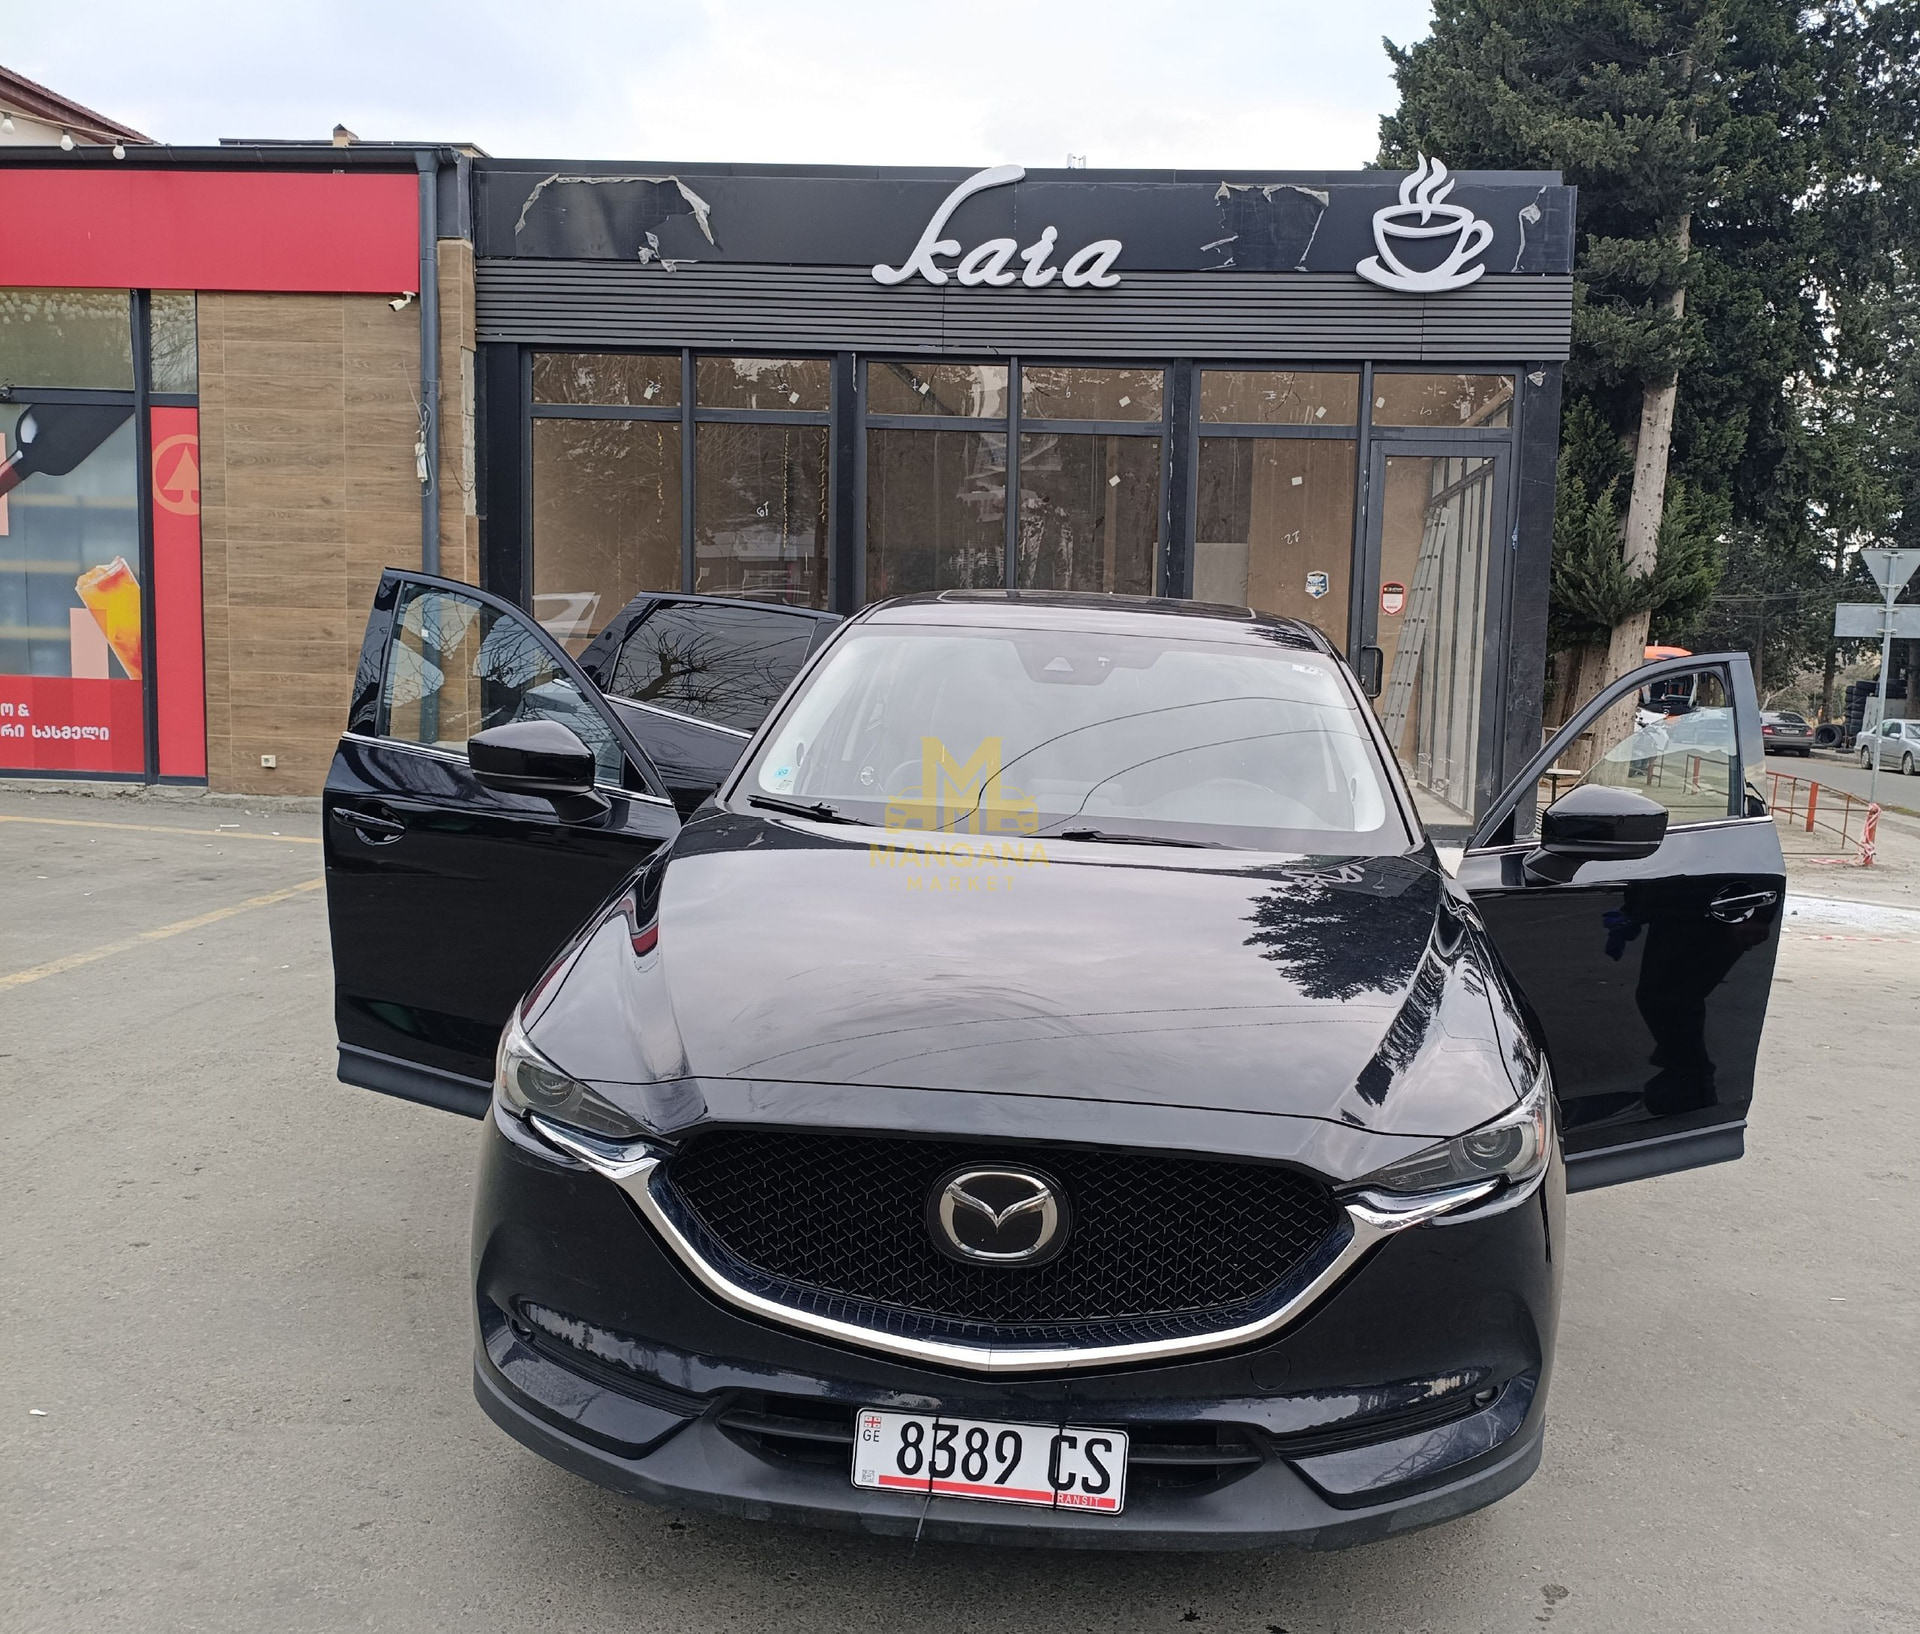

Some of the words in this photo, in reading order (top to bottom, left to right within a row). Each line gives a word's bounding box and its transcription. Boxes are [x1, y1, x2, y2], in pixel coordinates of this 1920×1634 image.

[18, 703, 30, 717] &
[32, 725, 110, 741] სასმელი
[863, 1429, 881, 1443] GE
[896, 1421, 1023, 1485] 8389
[1047, 1434, 1113, 1494] CS
[1050, 1493, 1102, 1508] TRANSIT
